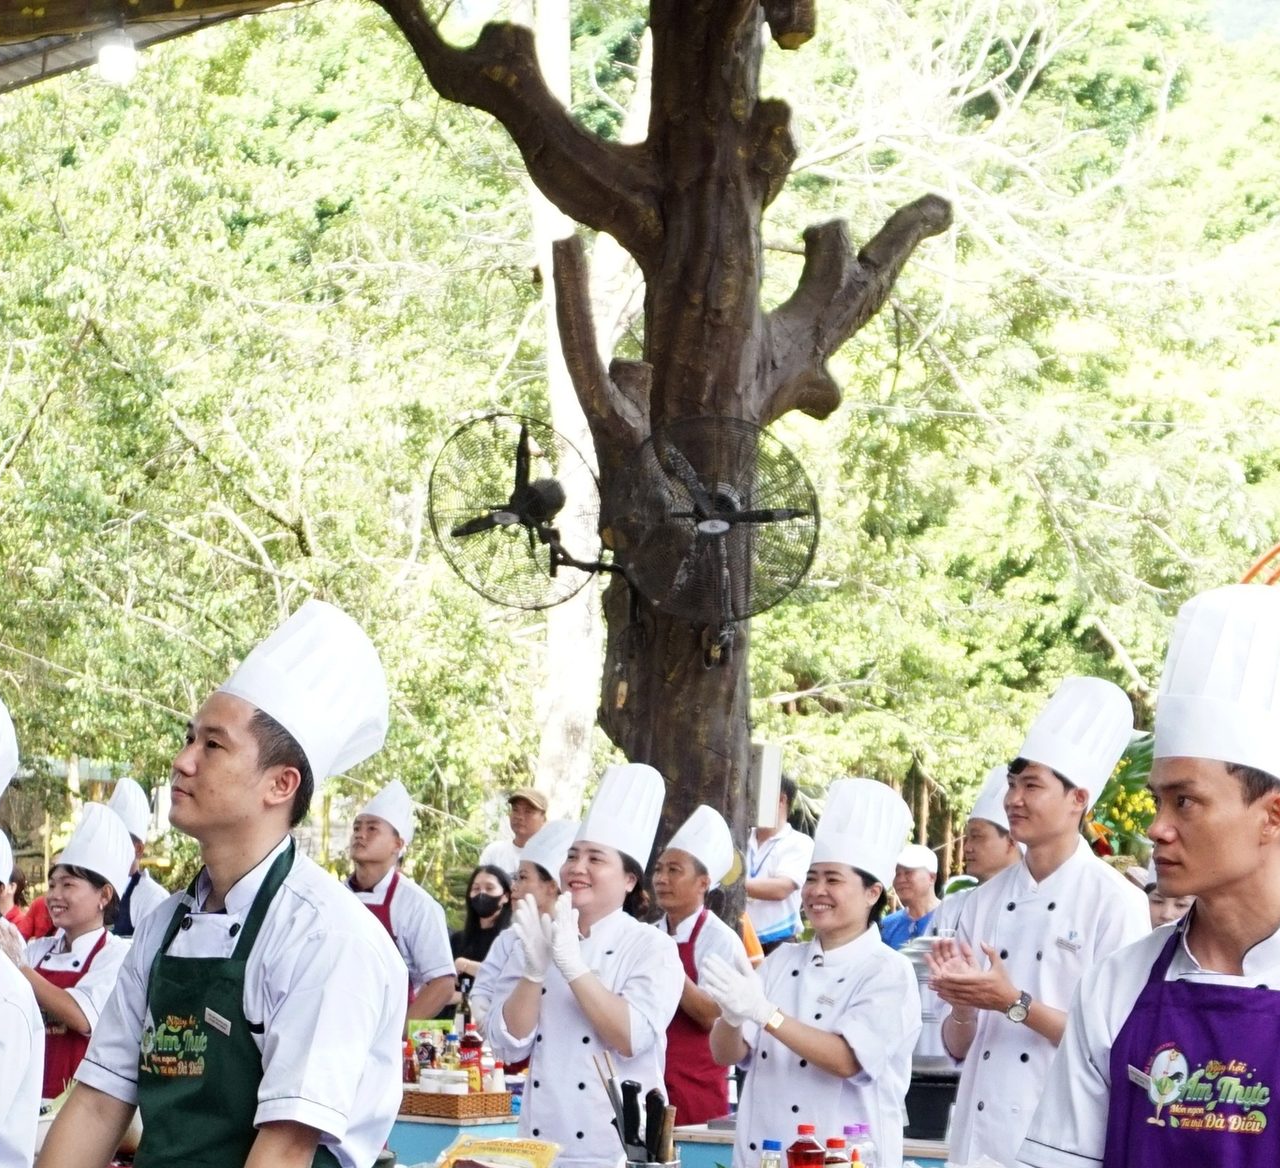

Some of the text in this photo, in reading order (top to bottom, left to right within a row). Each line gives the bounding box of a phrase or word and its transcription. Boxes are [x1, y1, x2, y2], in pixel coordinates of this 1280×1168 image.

[1217, 1076, 1271, 1111] Thực
[1187, 1107, 1205, 1117] ngon
[1204, 1112, 1225, 1130] Đà
